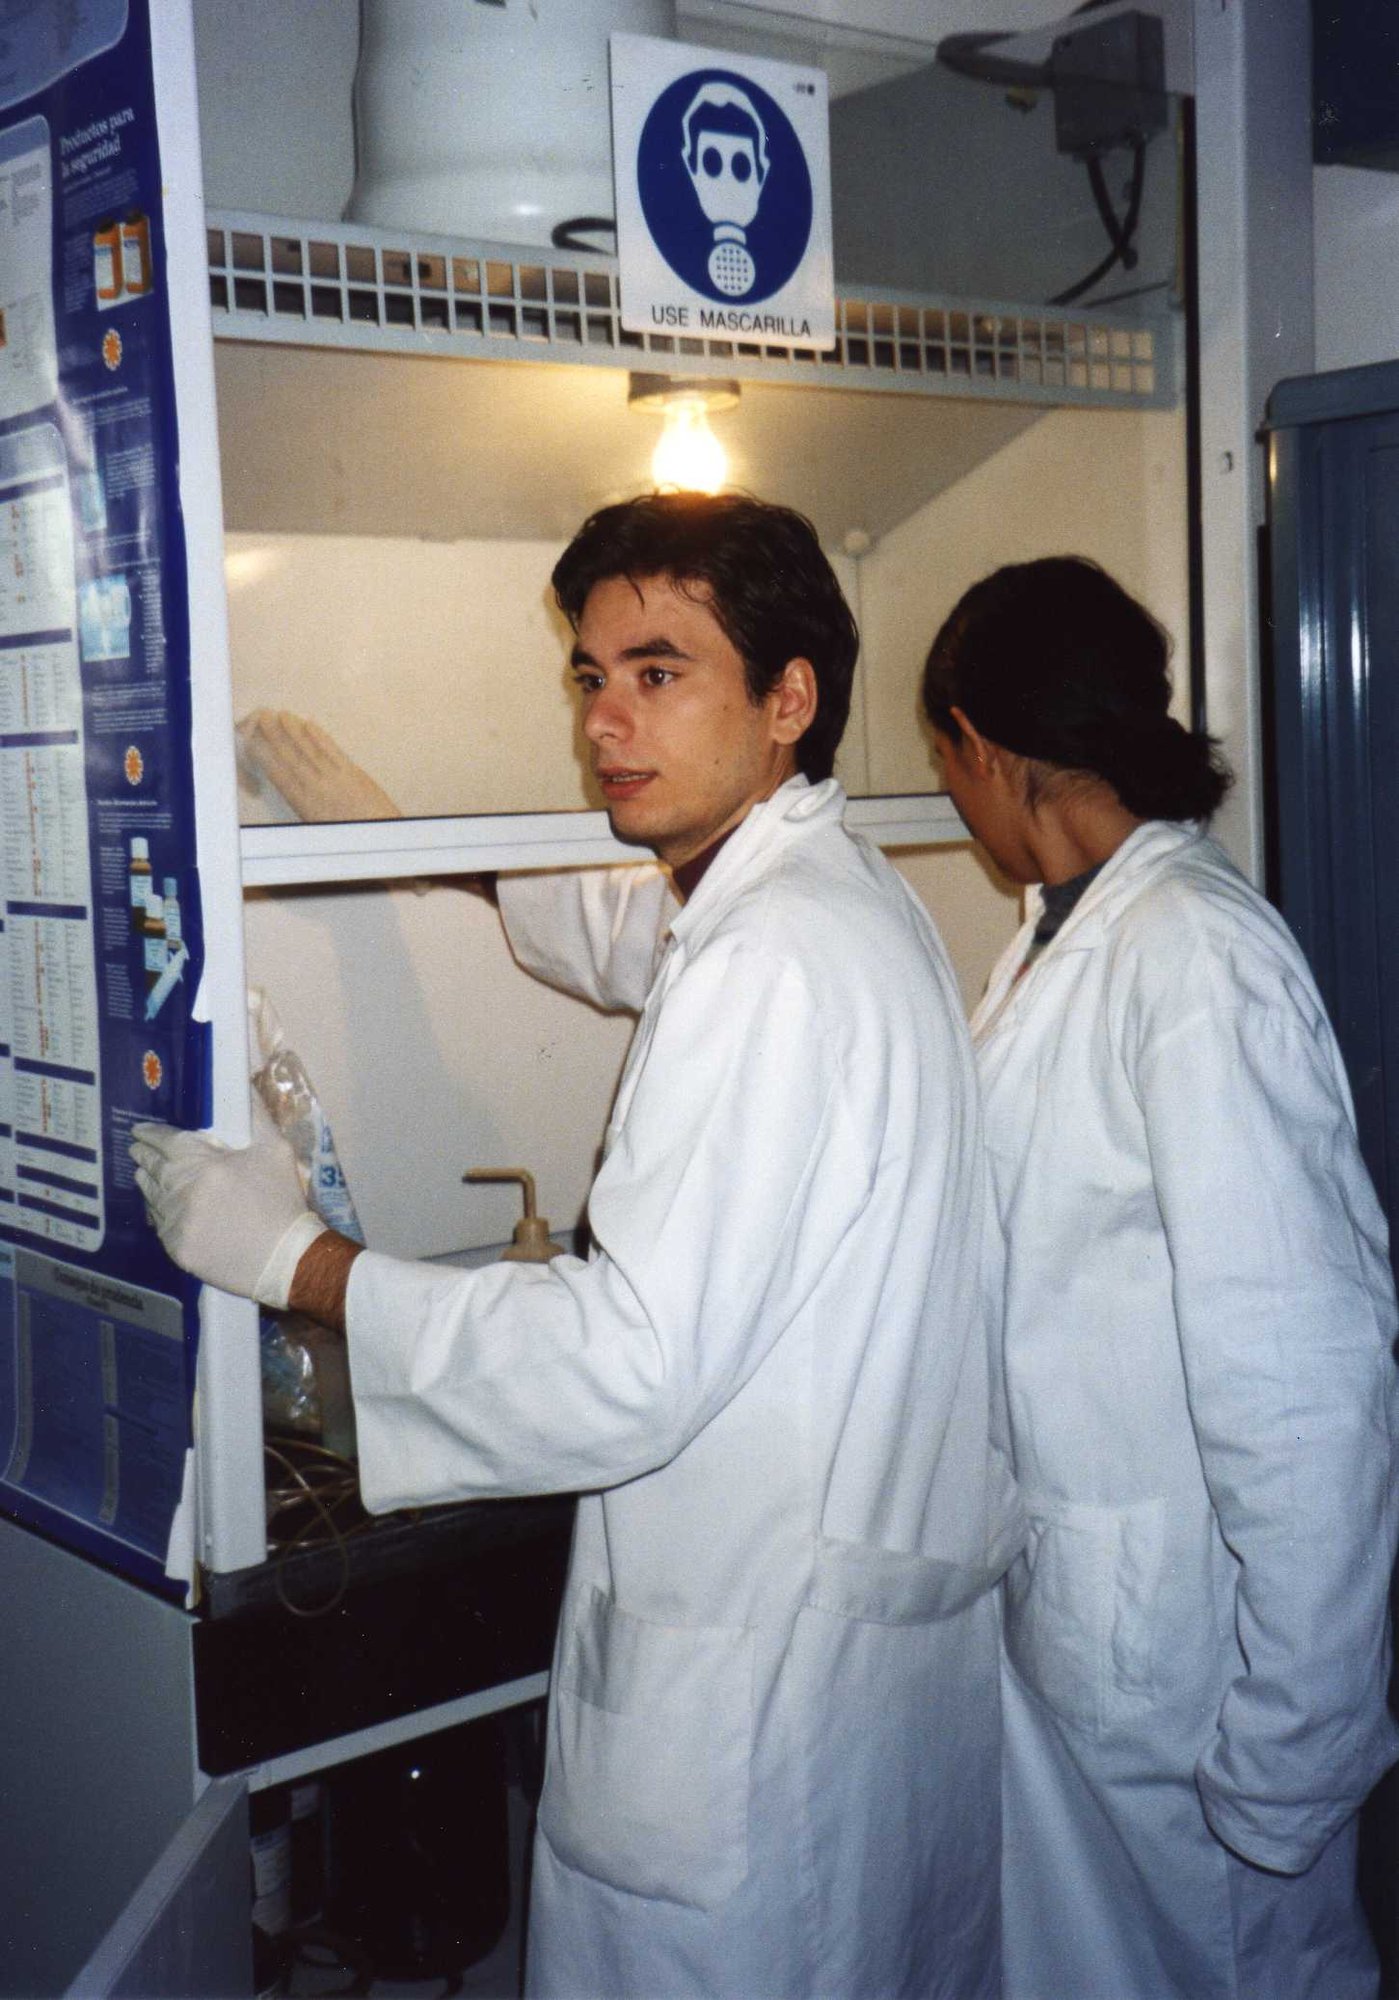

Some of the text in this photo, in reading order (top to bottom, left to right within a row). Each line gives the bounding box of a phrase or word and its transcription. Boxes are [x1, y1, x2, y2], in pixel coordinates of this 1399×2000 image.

[109, 107, 135, 135] para
[70, 134, 121, 175] seguridad
[652, 303, 811, 338] USE MASCARILLA
